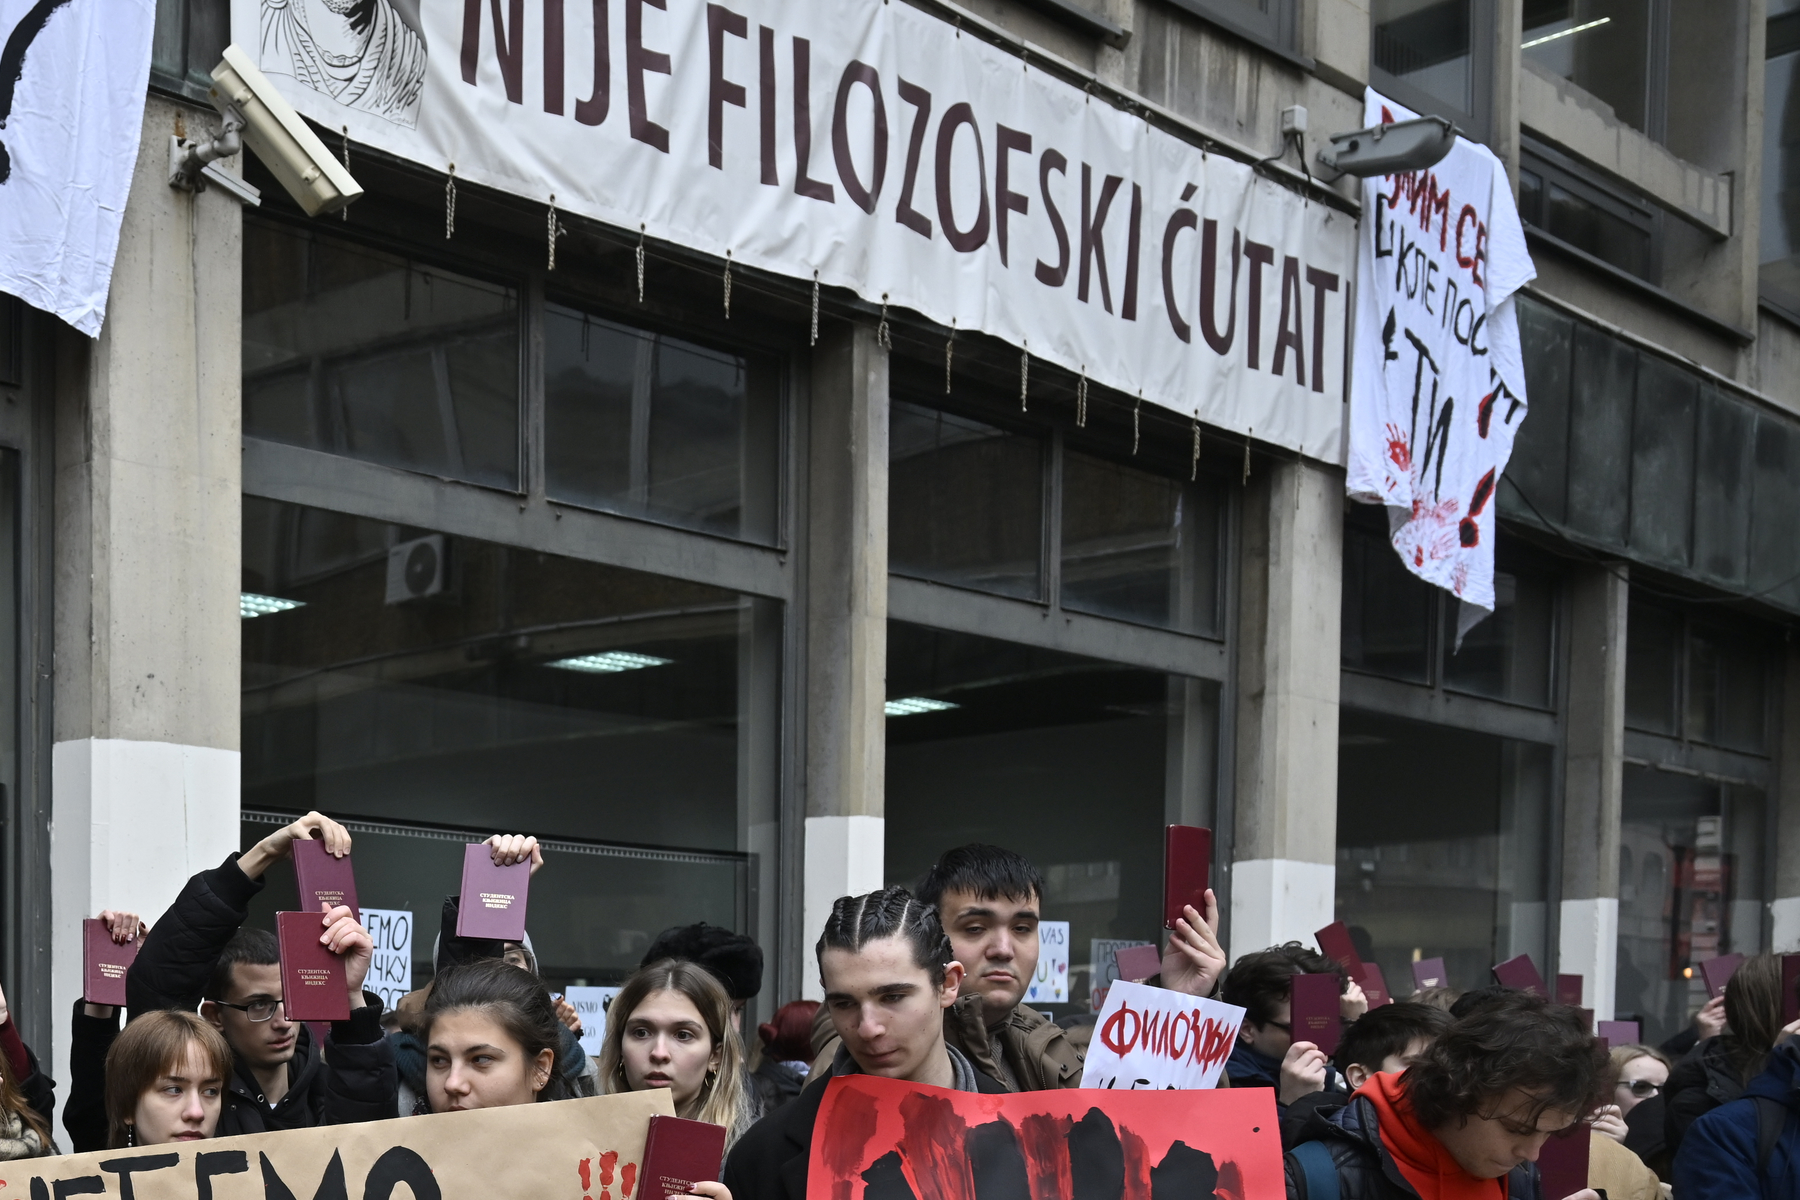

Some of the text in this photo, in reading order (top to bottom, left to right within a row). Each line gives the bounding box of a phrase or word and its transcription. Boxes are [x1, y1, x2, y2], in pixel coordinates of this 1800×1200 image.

[460, 0, 1351, 404] NIJE FILOZOFSKI ĆUTATI
[360, 913, 409, 951] ЕМО
[368, 954, 408, 984] ЧКУ
